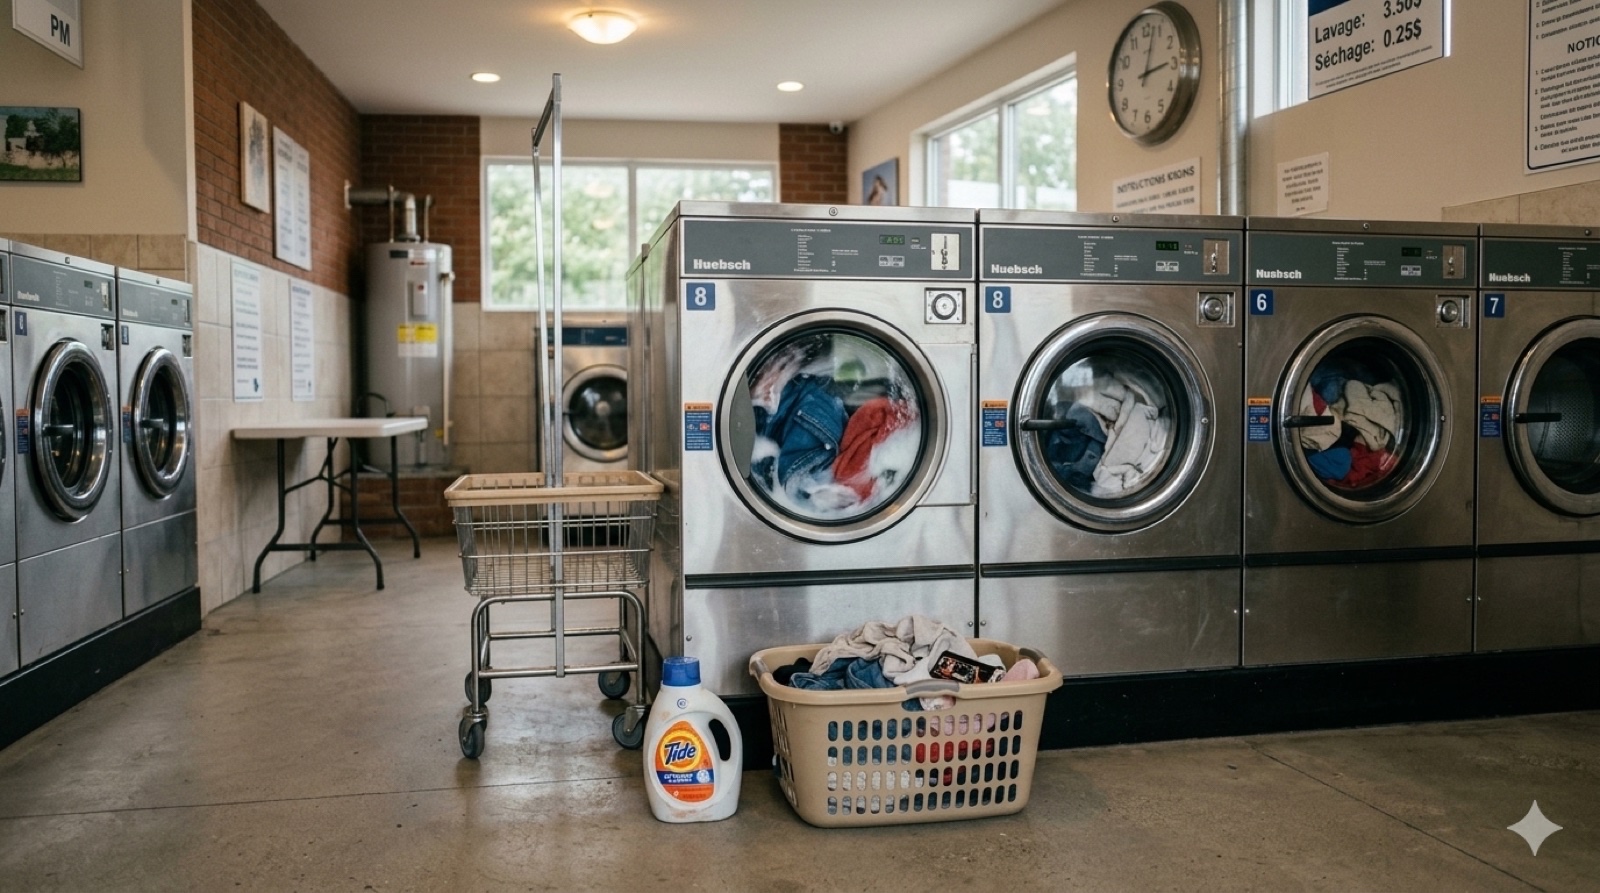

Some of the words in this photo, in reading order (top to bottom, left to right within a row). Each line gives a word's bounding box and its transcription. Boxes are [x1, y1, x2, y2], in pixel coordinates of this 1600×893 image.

[50, 13, 71, 47] PM
[1315, 13, 1366, 44] Lavage:
[1166, 35, 1174, 50] 2
[1315, 39, 1375, 71] Séchage:
[1383, 18, 1422, 48] 0.25$
[1170, 56, 1178, 70] 3
[1118, 78, 1125, 92] 9
[1167, 79, 1174, 92] 4
[1158, 98, 1165, 113] 5
[1144, 110, 1152, 123] 6
[693, 258, 751, 270] Huebsch
[694, 286, 707, 306] 8
[992, 290, 1004, 309] 8
[1256, 293, 1267, 311] 6
[1490, 297, 1499, 314] 7
[664, 741, 697, 765] Tide
